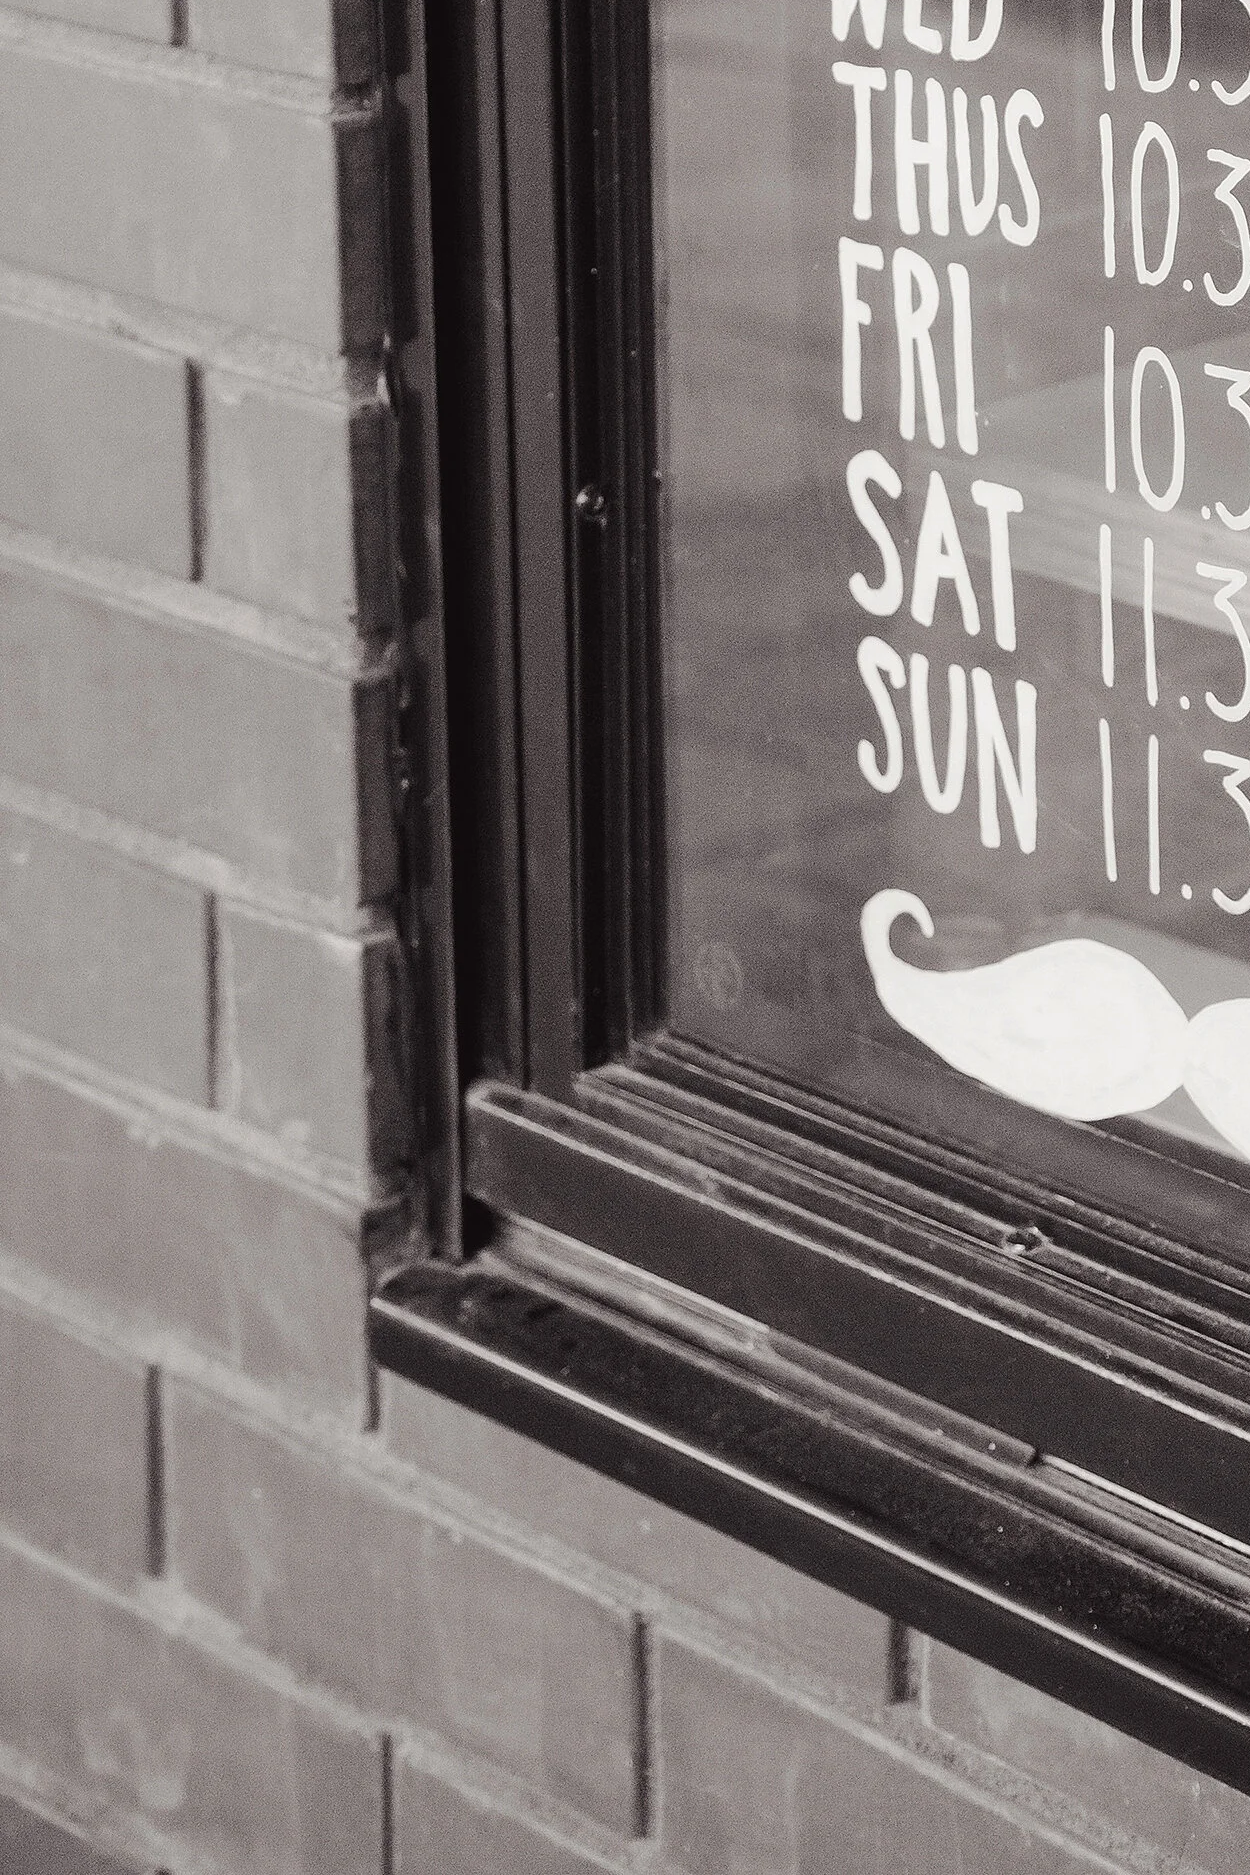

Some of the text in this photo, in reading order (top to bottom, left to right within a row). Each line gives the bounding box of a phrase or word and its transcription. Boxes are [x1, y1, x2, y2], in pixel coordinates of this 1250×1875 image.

[833, 61, 1044, 247] THUS
[838, 236, 980, 456] FRI
[845, 450, 1024, 652] SAT
[856, 636, 1038, 854] SUN
